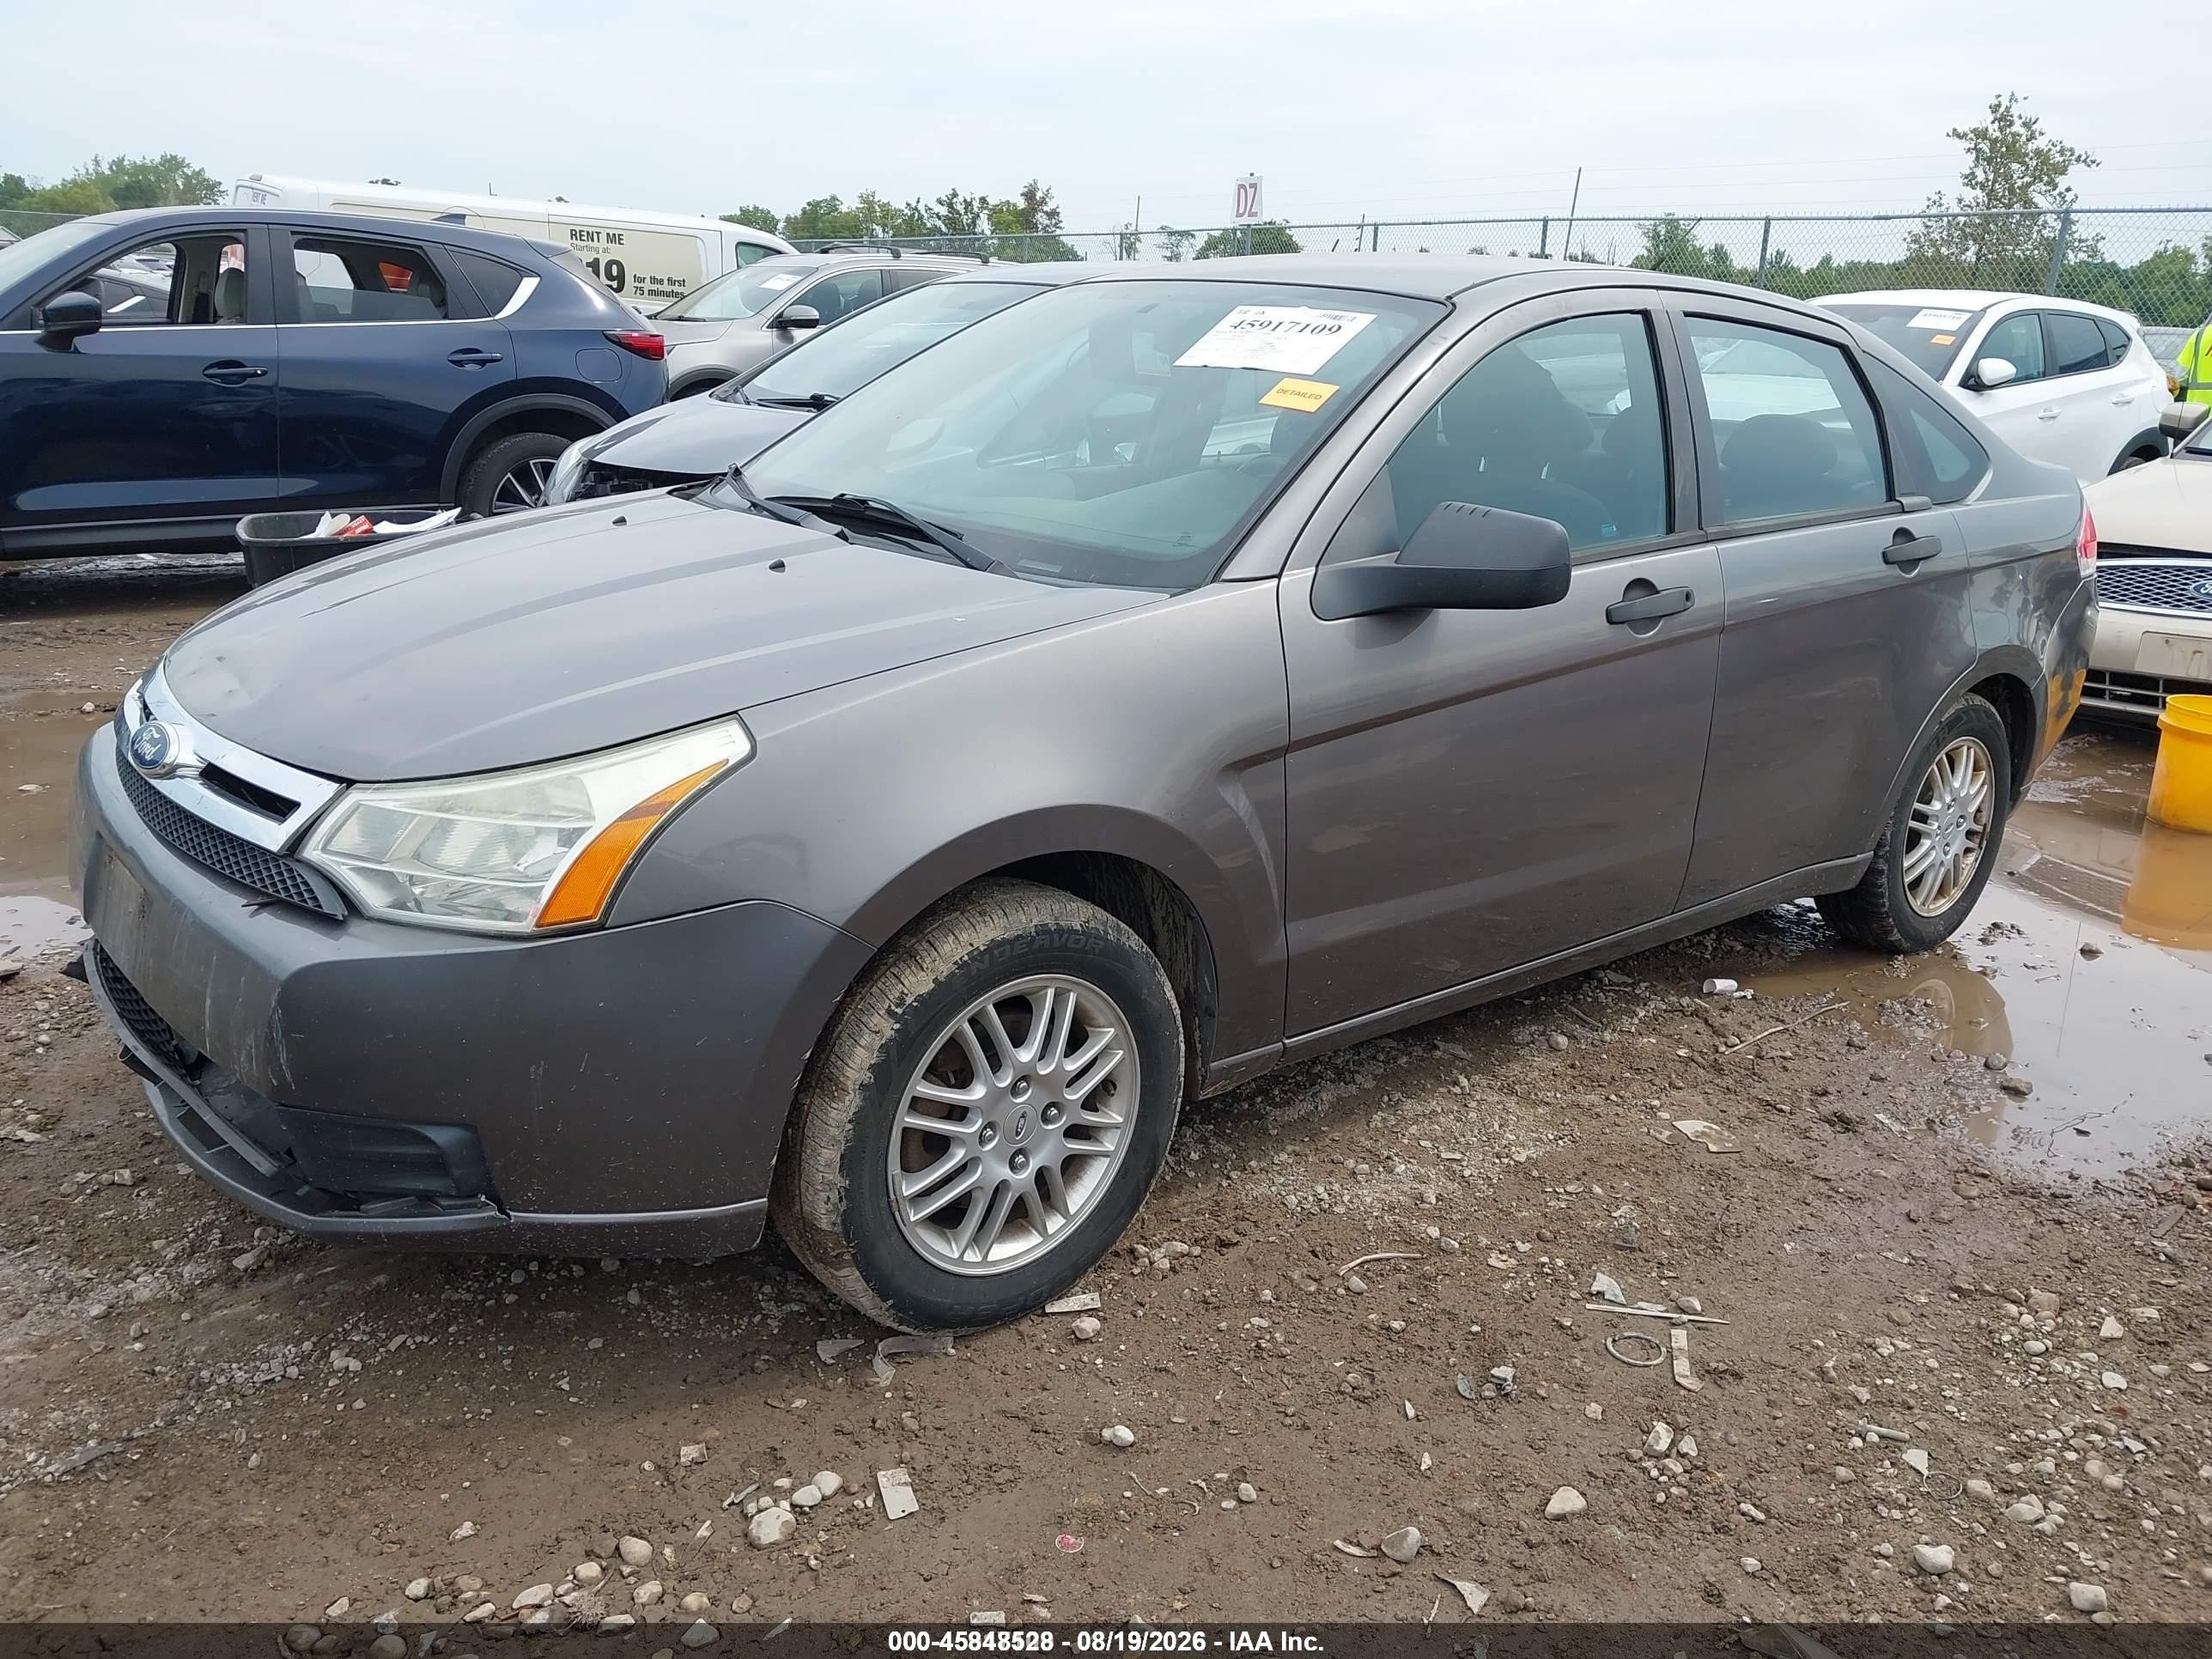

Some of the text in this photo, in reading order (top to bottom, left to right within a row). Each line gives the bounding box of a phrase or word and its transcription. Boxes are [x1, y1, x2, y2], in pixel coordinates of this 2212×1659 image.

[1236, 182, 1258, 218] DZ
[569, 228, 625, 246] RENT ME
[570, 242, 600, 254] Starting
[579, 257, 626, 293] 19
[633, 273, 686, 288] for the first
[633, 286, 684, 299] 75 minutes
[1230, 319, 1342, 336] 45917109
[1276, 388, 1322, 400] DETAILED
[134, 726, 161, 761] Ford
